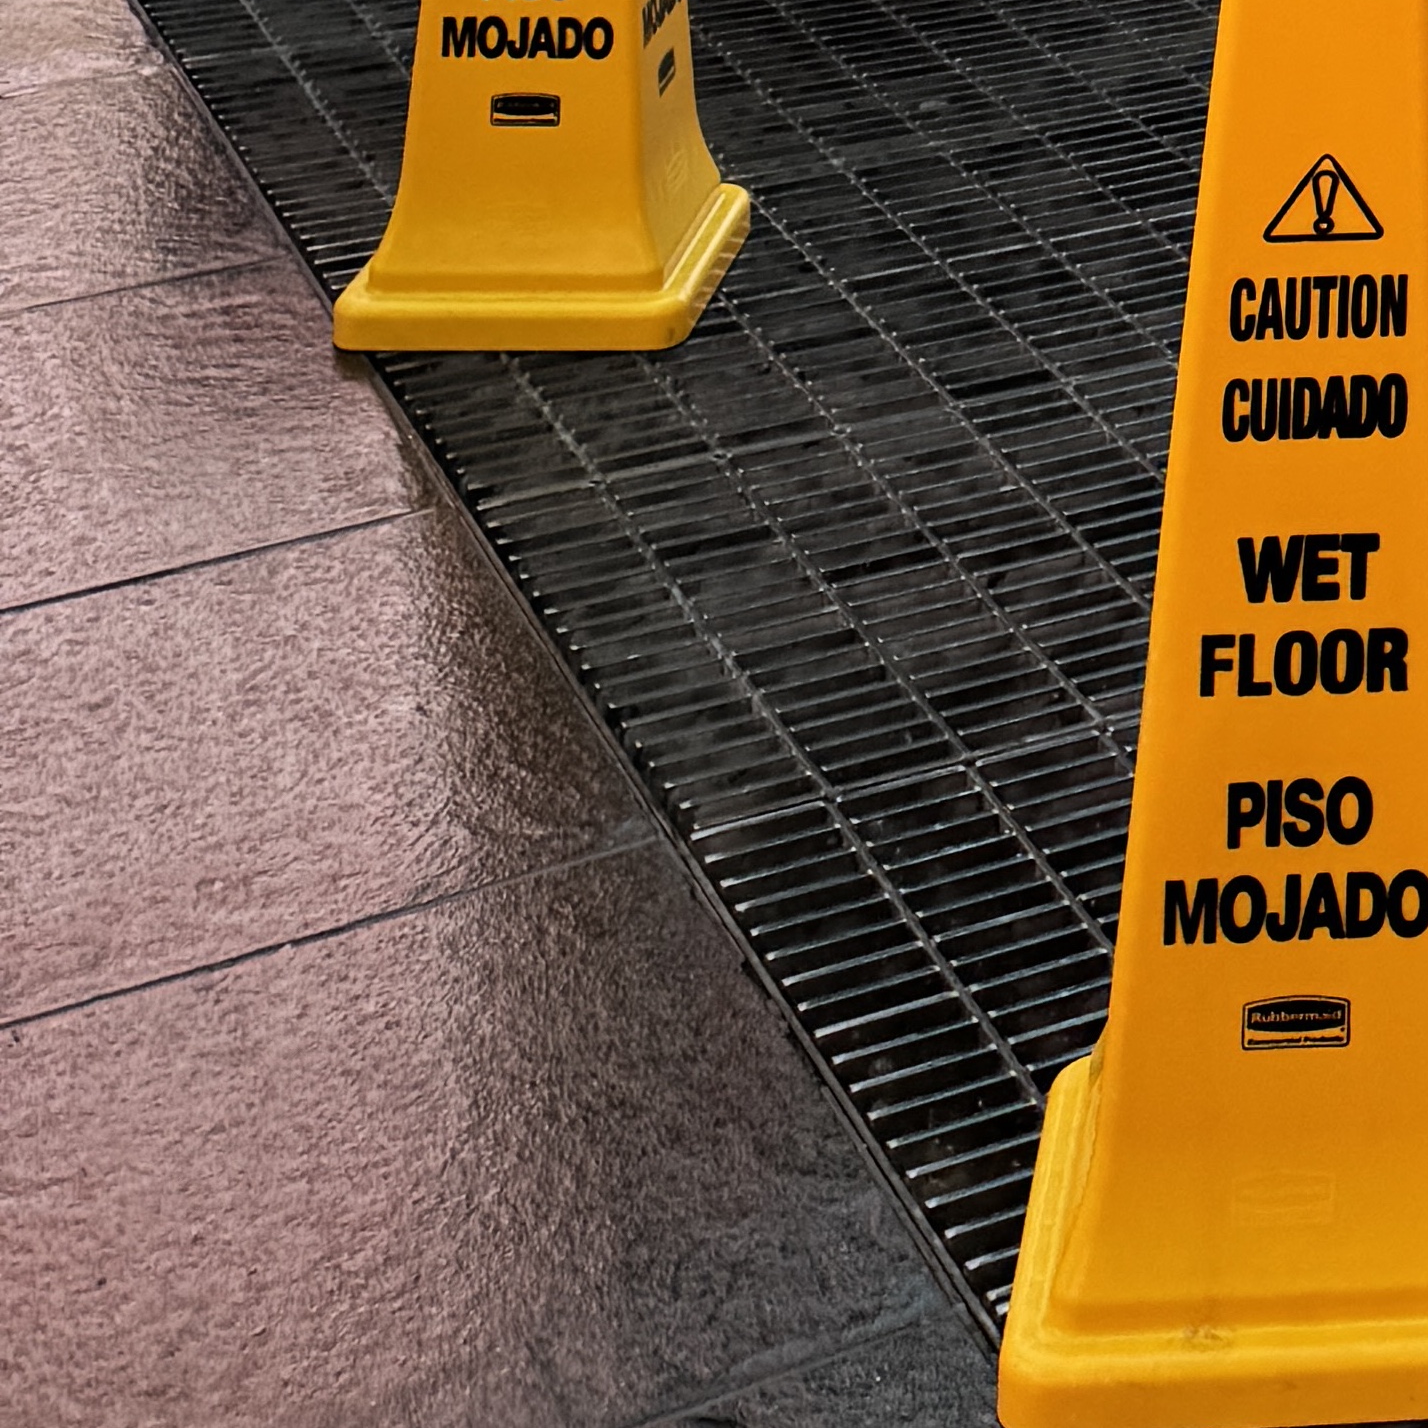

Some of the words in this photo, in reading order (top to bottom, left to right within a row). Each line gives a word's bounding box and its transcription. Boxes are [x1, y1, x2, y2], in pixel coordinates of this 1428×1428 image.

[441, 16, 615, 60] MOJADO
[1229, 274, 1409, 342] CAUTION
[1221, 373, 1409, 443] CUIDADO
[1236, 532, 1381, 604] WET
[1199, 627, 1409, 697] FLOOR
[1226, 775, 1374, 850] PISO
